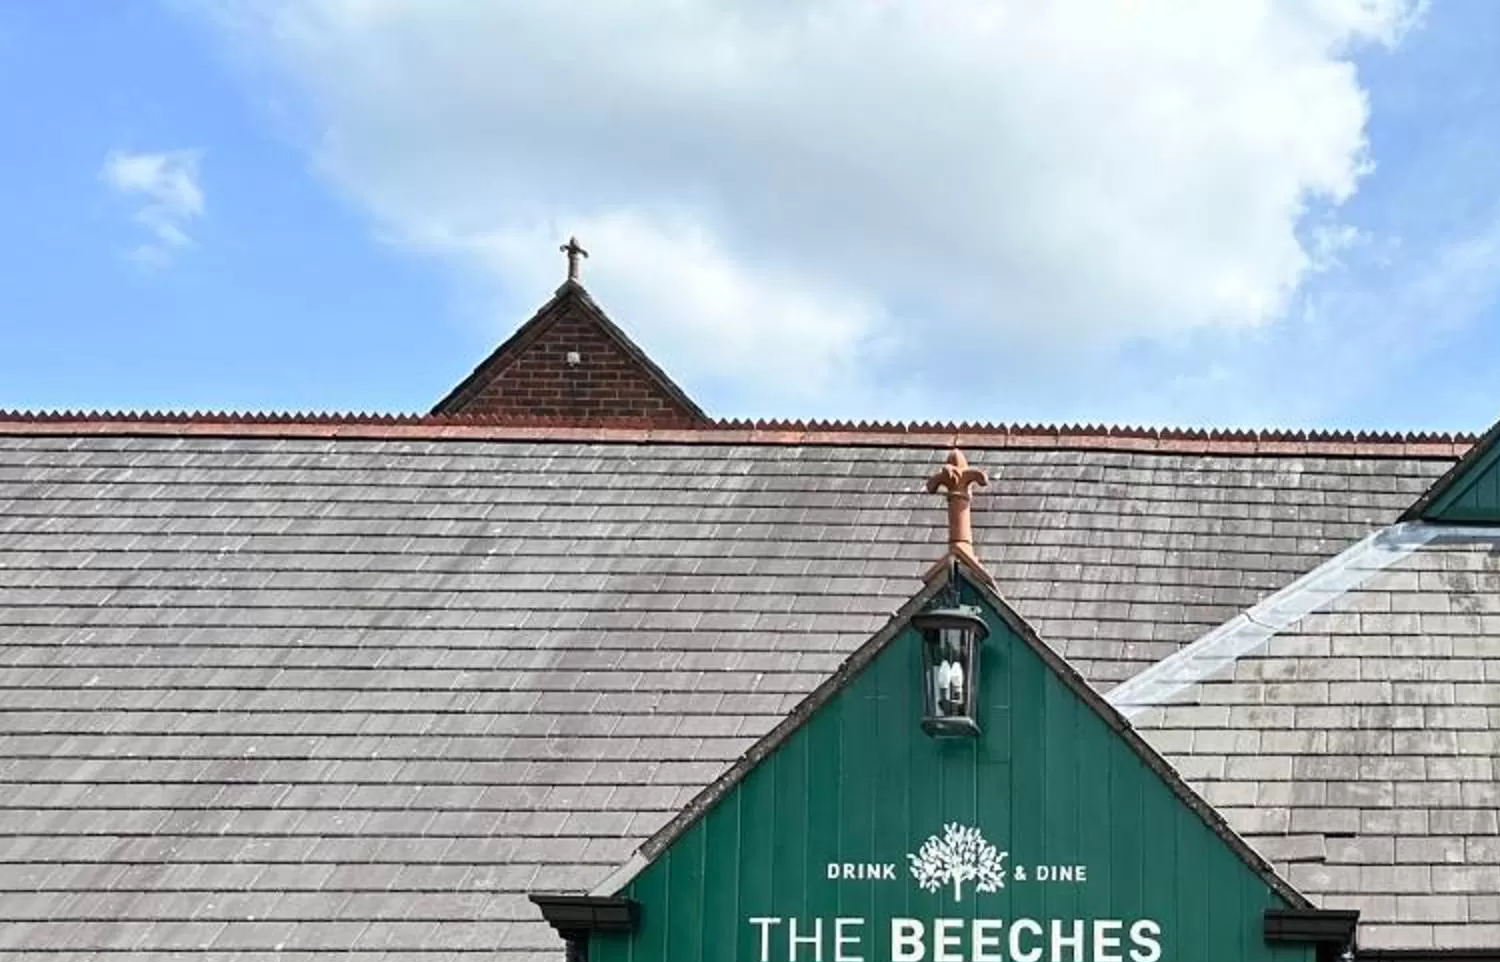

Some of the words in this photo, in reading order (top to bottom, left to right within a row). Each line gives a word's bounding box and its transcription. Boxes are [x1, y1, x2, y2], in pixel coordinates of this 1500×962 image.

[827, 863, 896, 880] DRINK
[1014, 865, 1027, 881] &
[1036, 865, 1087, 882] DINE
[748, 917, 865, 962] THE
